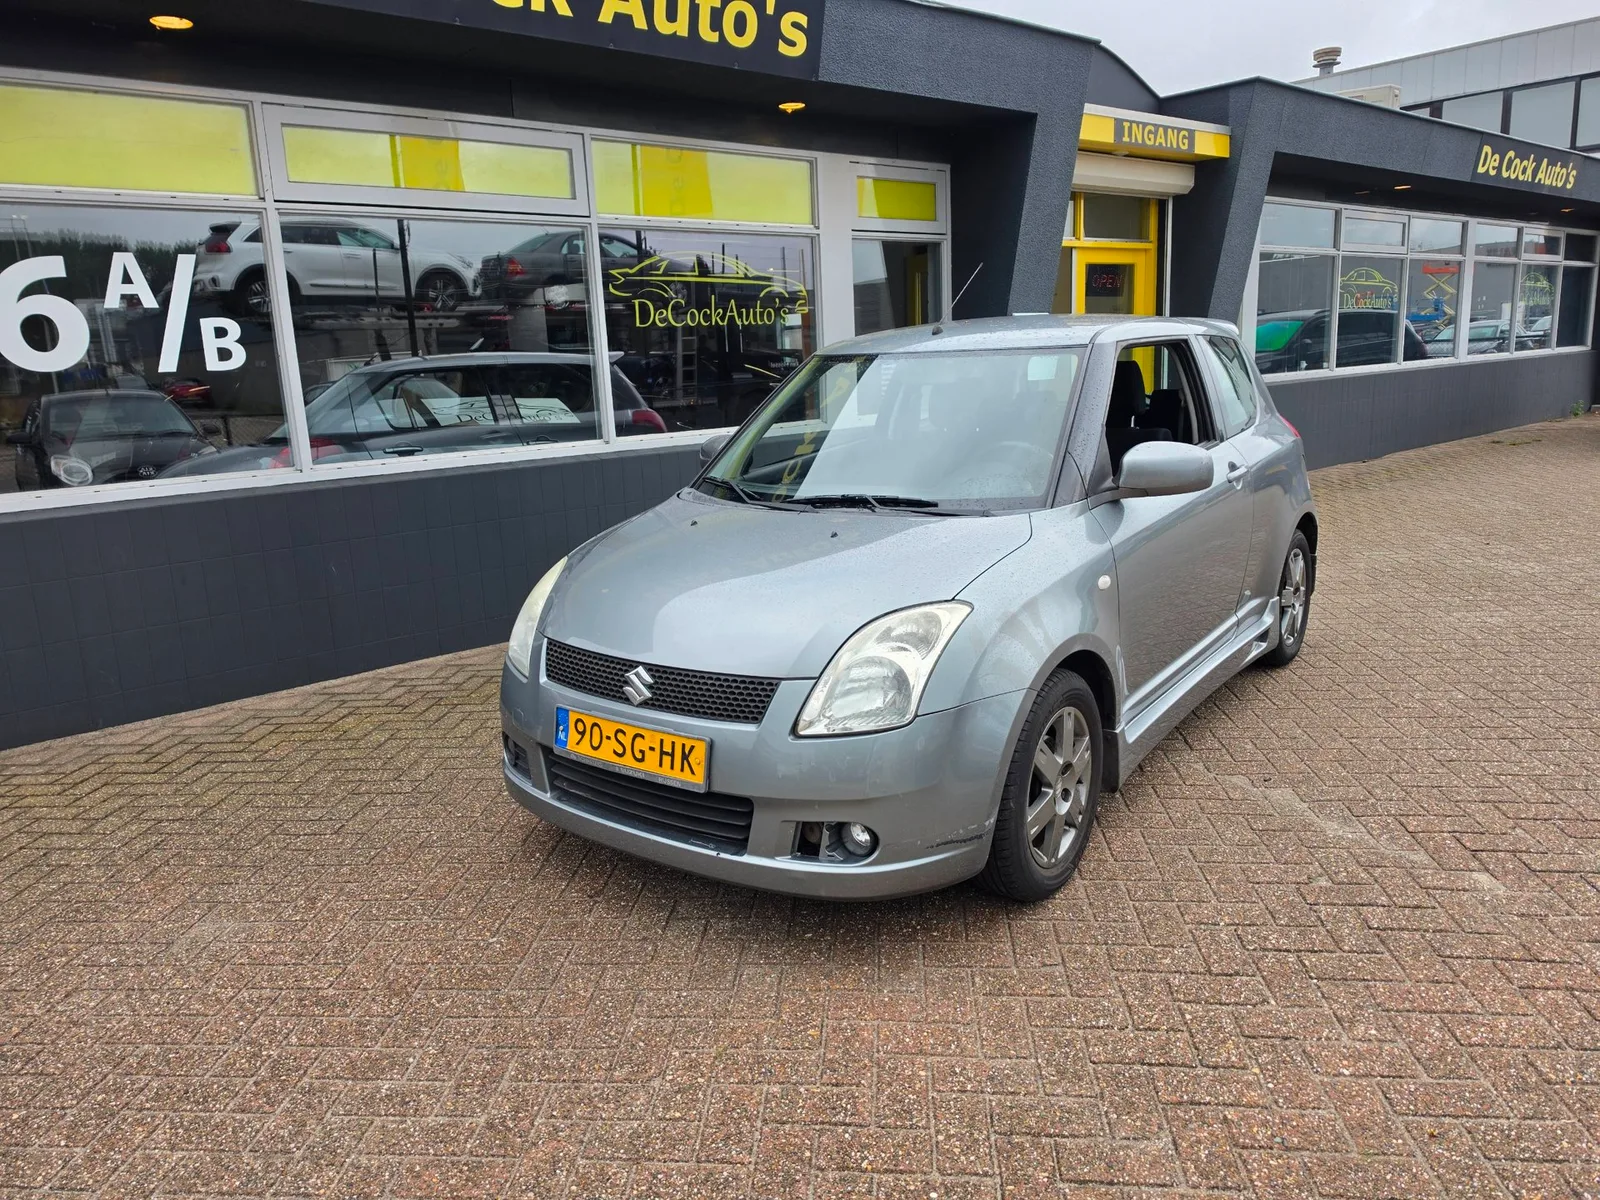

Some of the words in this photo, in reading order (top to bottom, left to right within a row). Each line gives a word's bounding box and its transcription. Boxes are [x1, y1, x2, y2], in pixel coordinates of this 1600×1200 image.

[1122, 121, 1189, 150] INGANG
[1477, 145, 1500, 176] De
[1501, 150, 1536, 182] Cock
[1534, 158, 1577, 189] Auto's
[1092, 274, 1123, 288] OPEN
[632, 294, 789, 328] DeCockAuto's
[574, 717, 697, 776] 90-SG-HK
